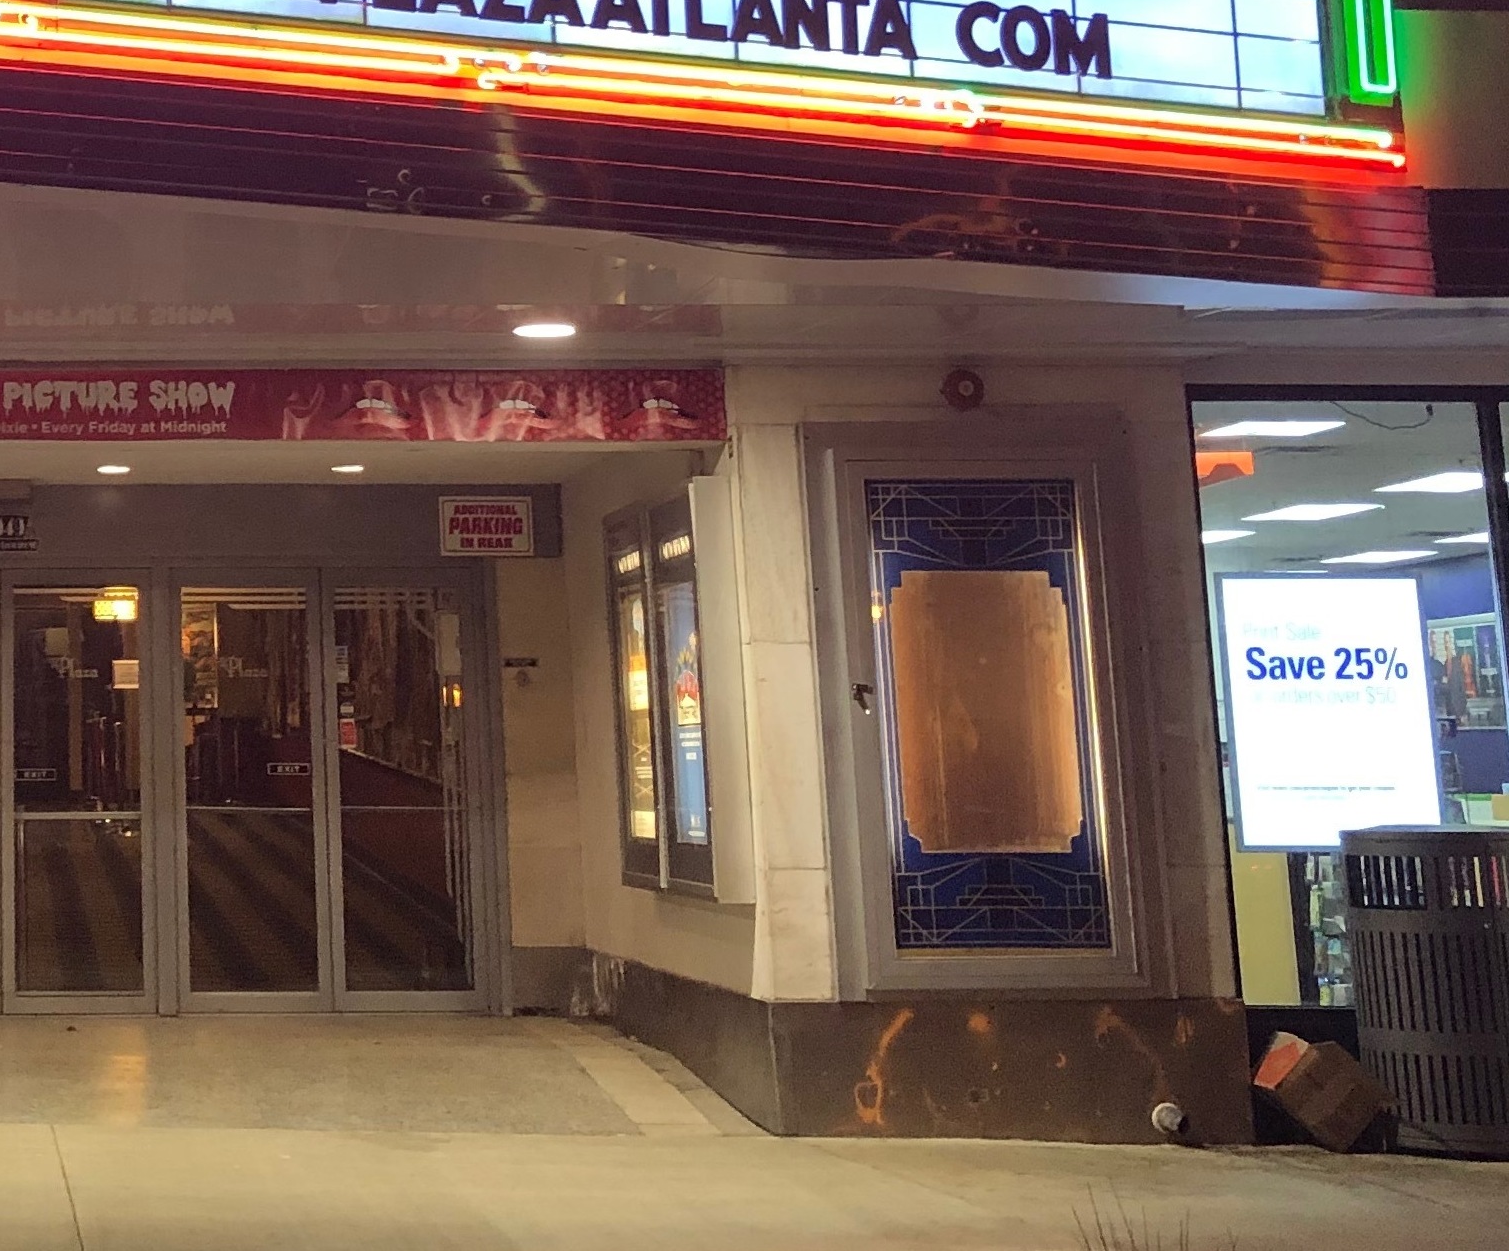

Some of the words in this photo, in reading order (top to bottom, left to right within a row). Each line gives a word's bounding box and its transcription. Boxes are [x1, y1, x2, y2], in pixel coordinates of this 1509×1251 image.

[955, 0, 1113, 80] COM
[3, 379, 139, 418] PICTURE
[148, 379, 236, 418] SHOW
[41, 421, 84, 436] Every
[88, 420, 140, 435] Friday
[142, 422, 157, 434] at
[160, 420, 228, 436] Midnight
[448, 517, 524, 535] PARKING
[477, 538, 513, 549] REAR
[1245, 646, 1326, 681] Save
[1333, 646, 1409, 681] 25%
